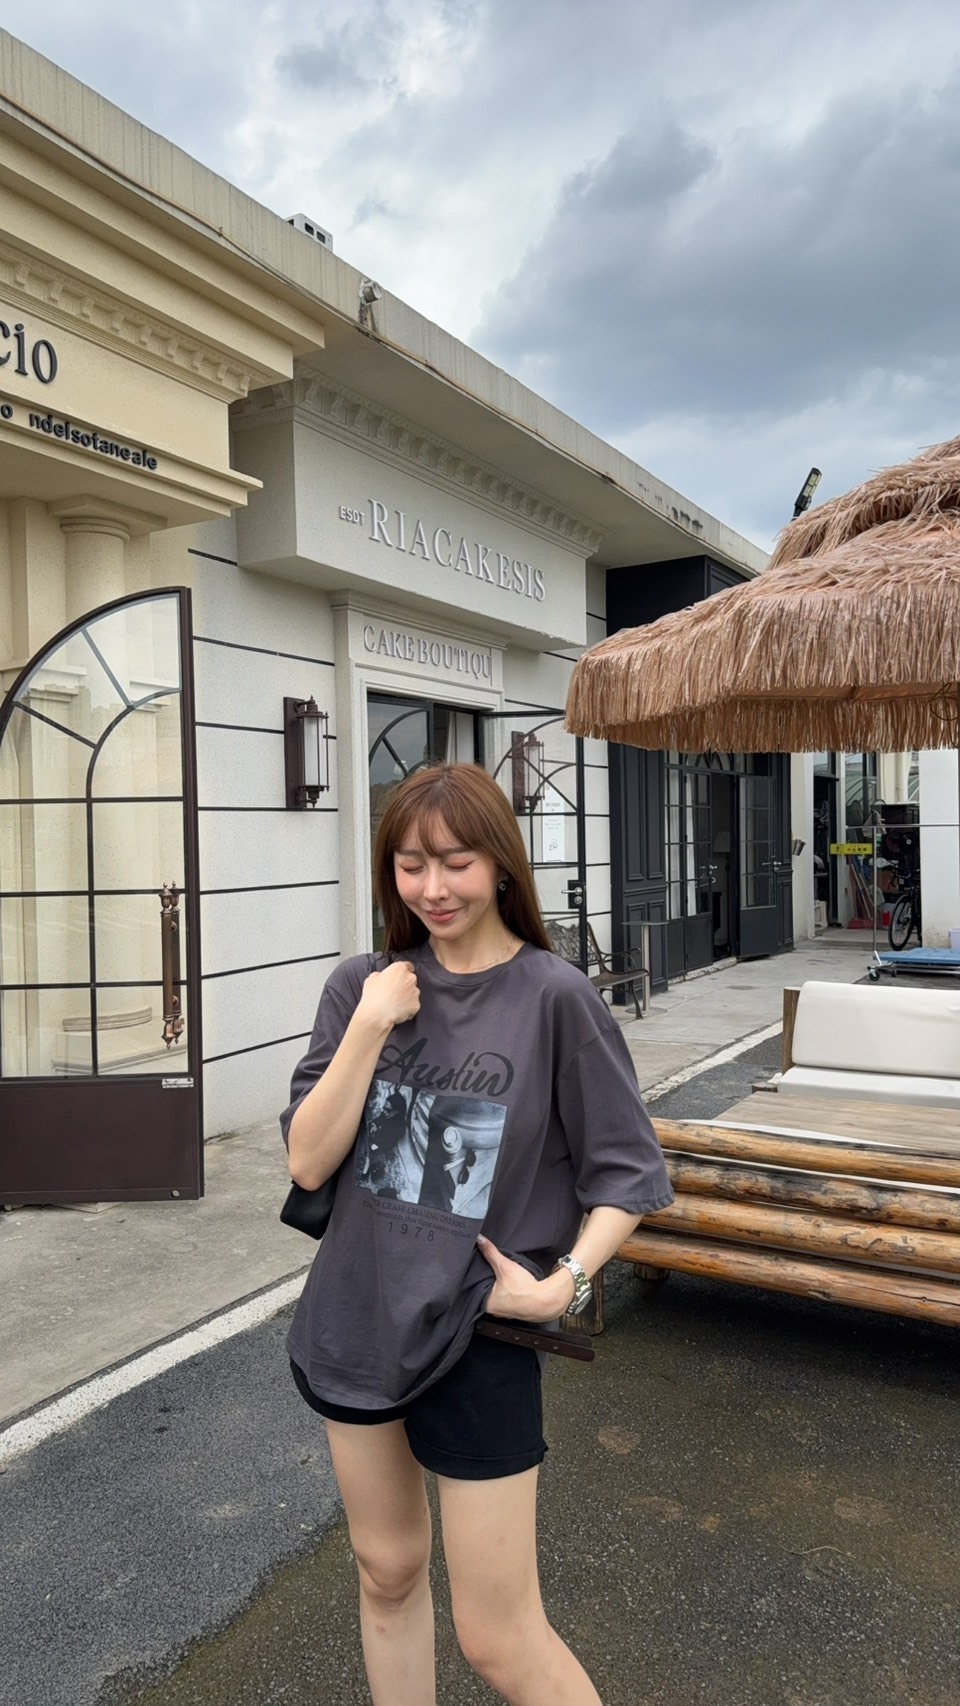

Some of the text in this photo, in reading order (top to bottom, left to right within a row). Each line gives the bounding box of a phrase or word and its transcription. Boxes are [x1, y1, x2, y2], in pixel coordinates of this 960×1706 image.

[338, 499, 547, 602] ESDT RIACAKESIS
[375, 1036, 515, 1098] Austin
